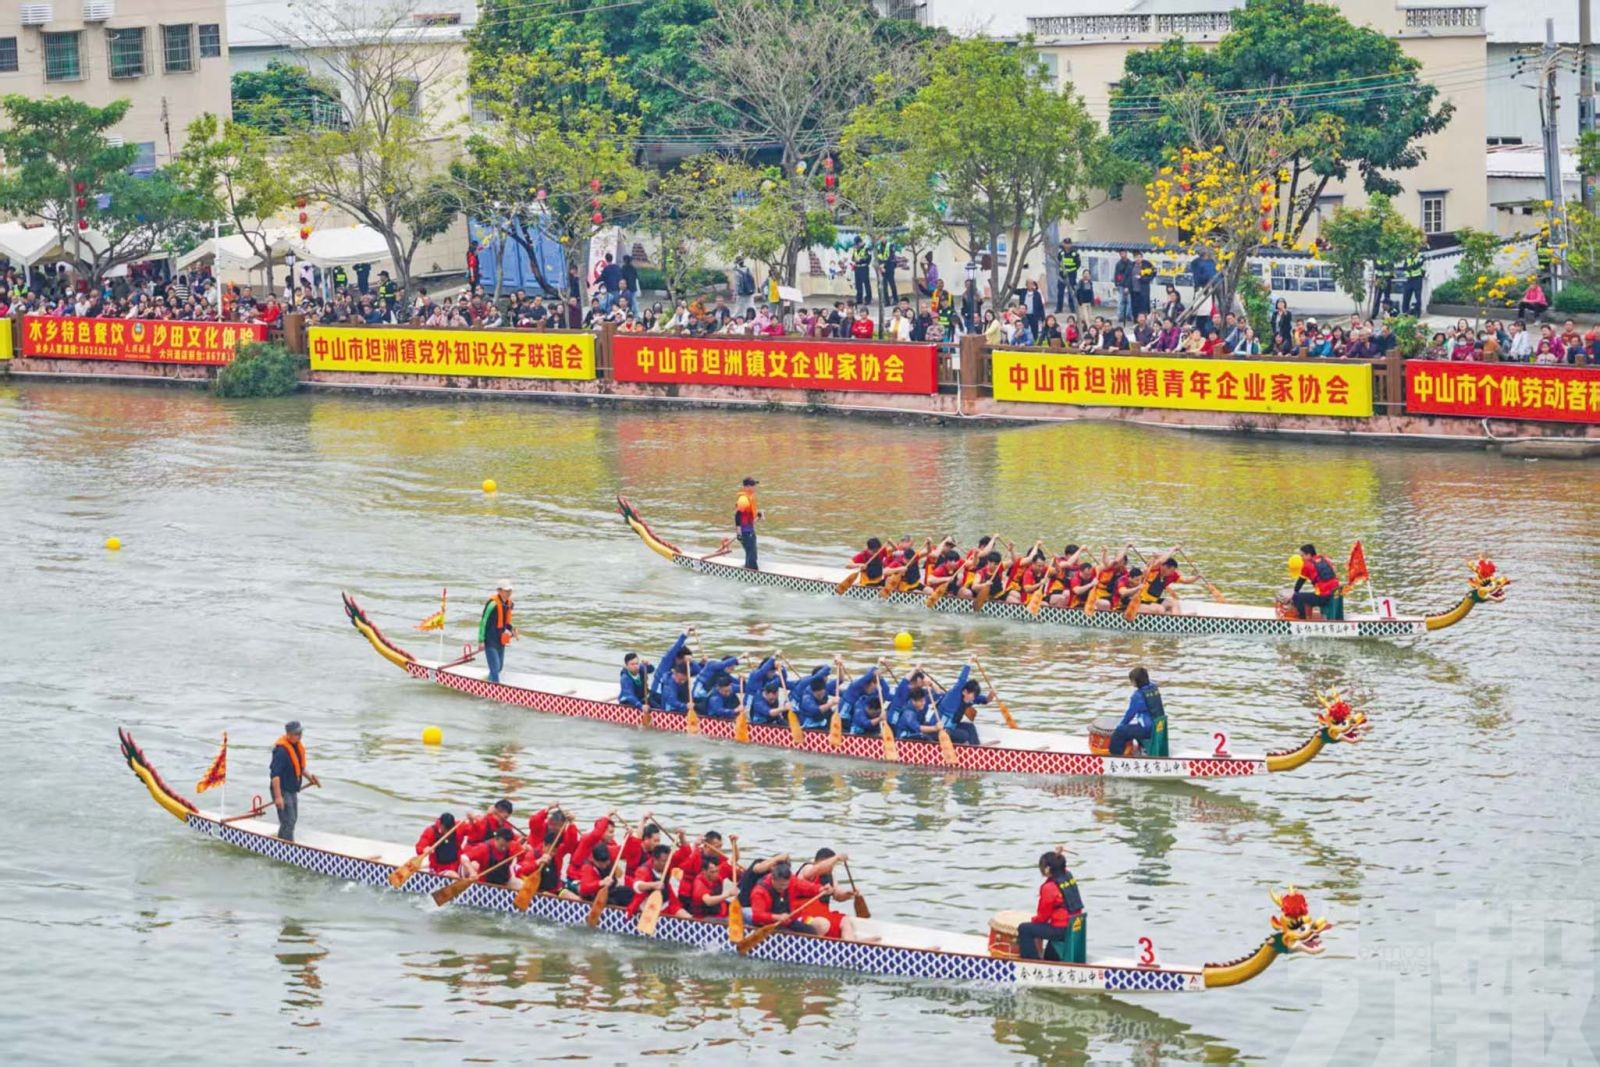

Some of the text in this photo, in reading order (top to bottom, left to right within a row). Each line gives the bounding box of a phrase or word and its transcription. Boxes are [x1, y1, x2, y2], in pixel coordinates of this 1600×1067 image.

[29, 319, 124, 345] 水乡特色餐饮
[153, 323, 254, 350] 沙田文化体验
[313, 336, 583, 370] 中山市坦洲镇党外知识分子联谊会
[636, 346, 905, 383] 中山市坦洲镇女企业家协会
[1008, 362, 1350, 405] 中山市坦洲镇青年企业家协会
[1382, 599, 1392, 618] 1
[1213, 732, 1228, 755] 2
[1138, 937, 1156, 965] 3
